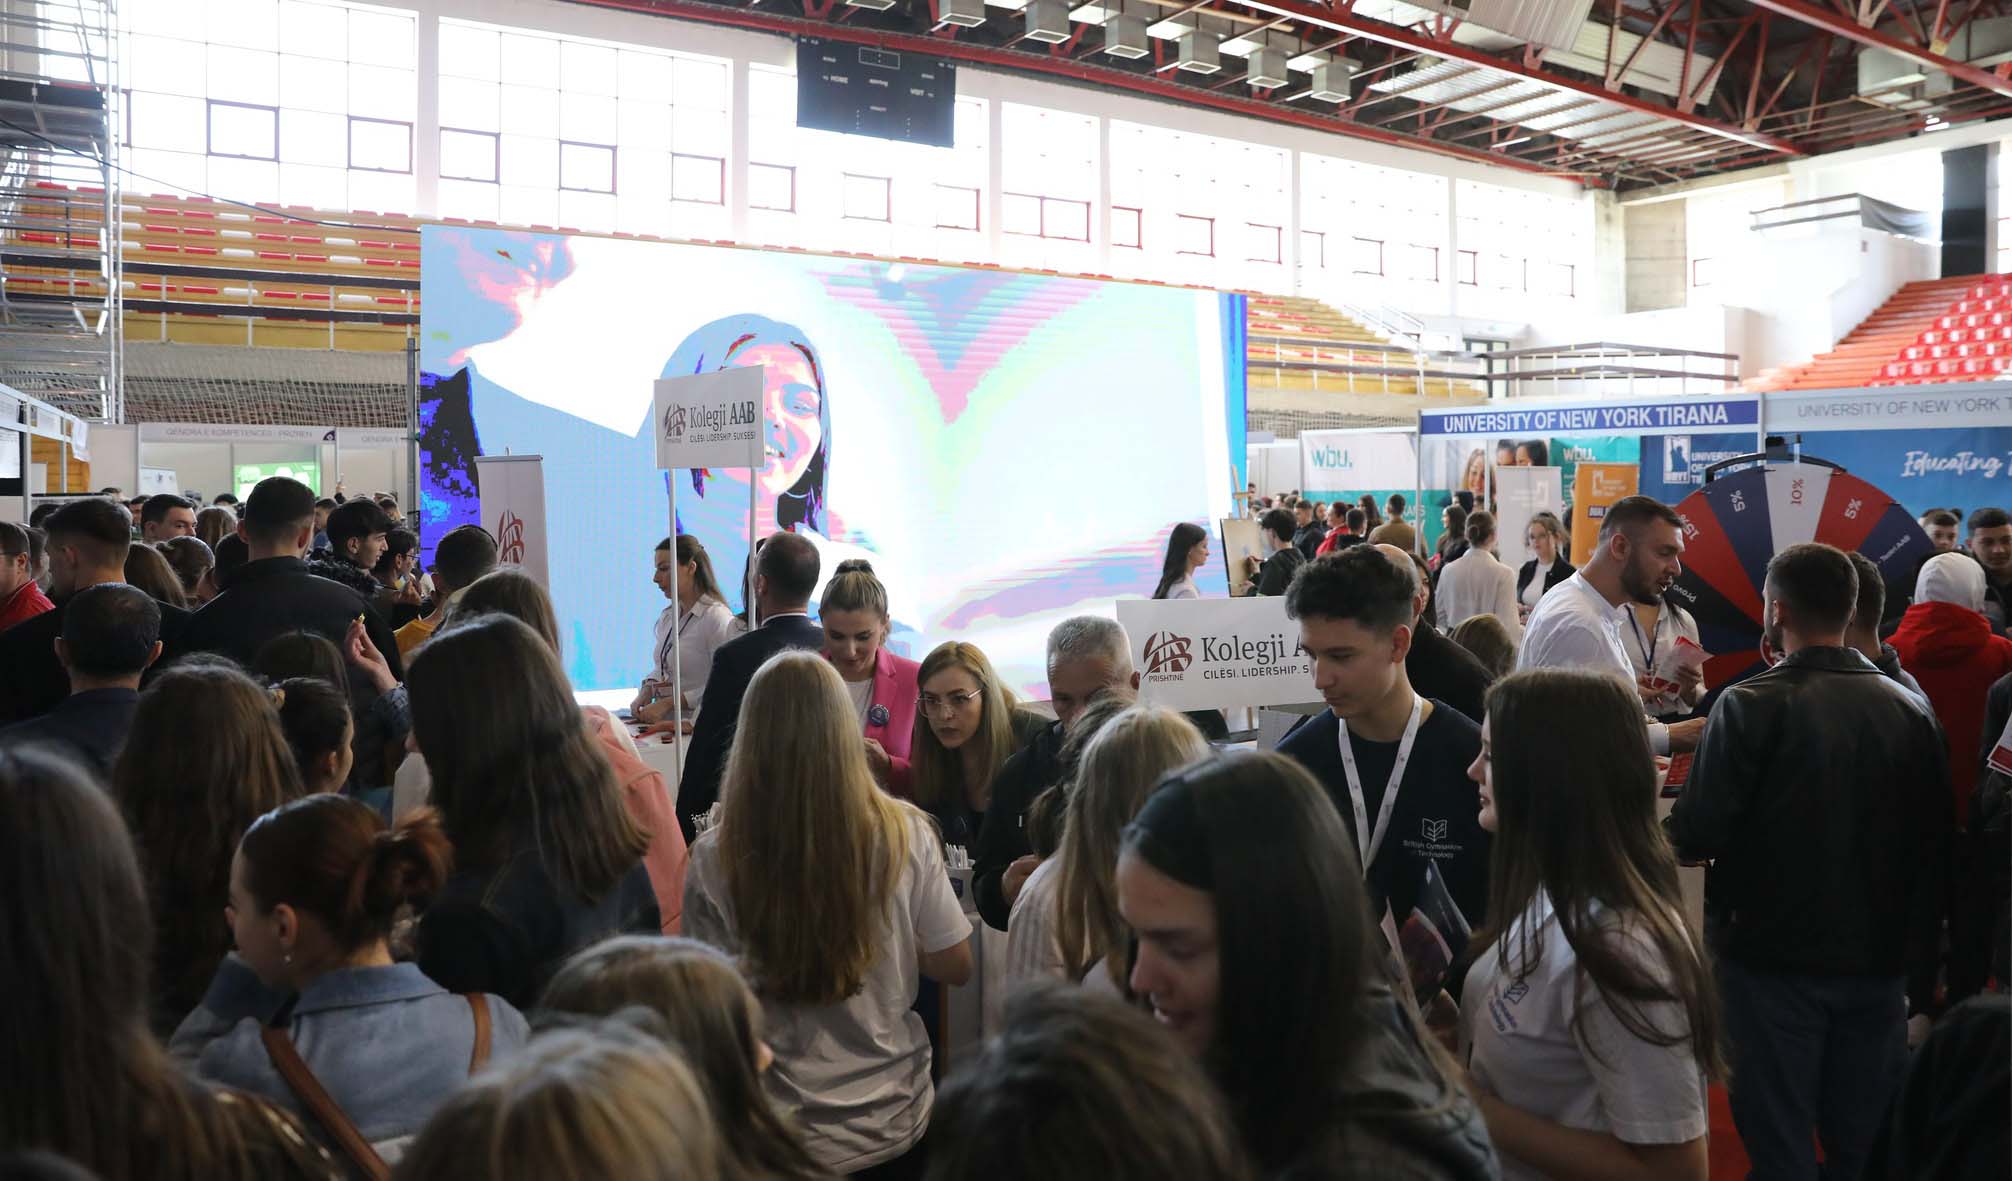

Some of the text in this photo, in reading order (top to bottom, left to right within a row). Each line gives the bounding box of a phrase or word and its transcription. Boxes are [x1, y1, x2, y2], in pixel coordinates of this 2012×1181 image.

[690, 401, 755, 431] Kolegji AAB
[1443, 404, 1729, 433] UNIVERSITY OF NEW YORK TIRANA
[1797, 402, 1882, 418] UNIVERSITY
[1887, 401, 1905, 414] OF
[1912, 400, 1949, 413] NEW
[1954, 397, 2000, 412] YORK
[1790, 478, 1804, 505] 10%
[1844, 498, 1863, 520] 5%
[1201, 633, 1286, 666] Kolegji
